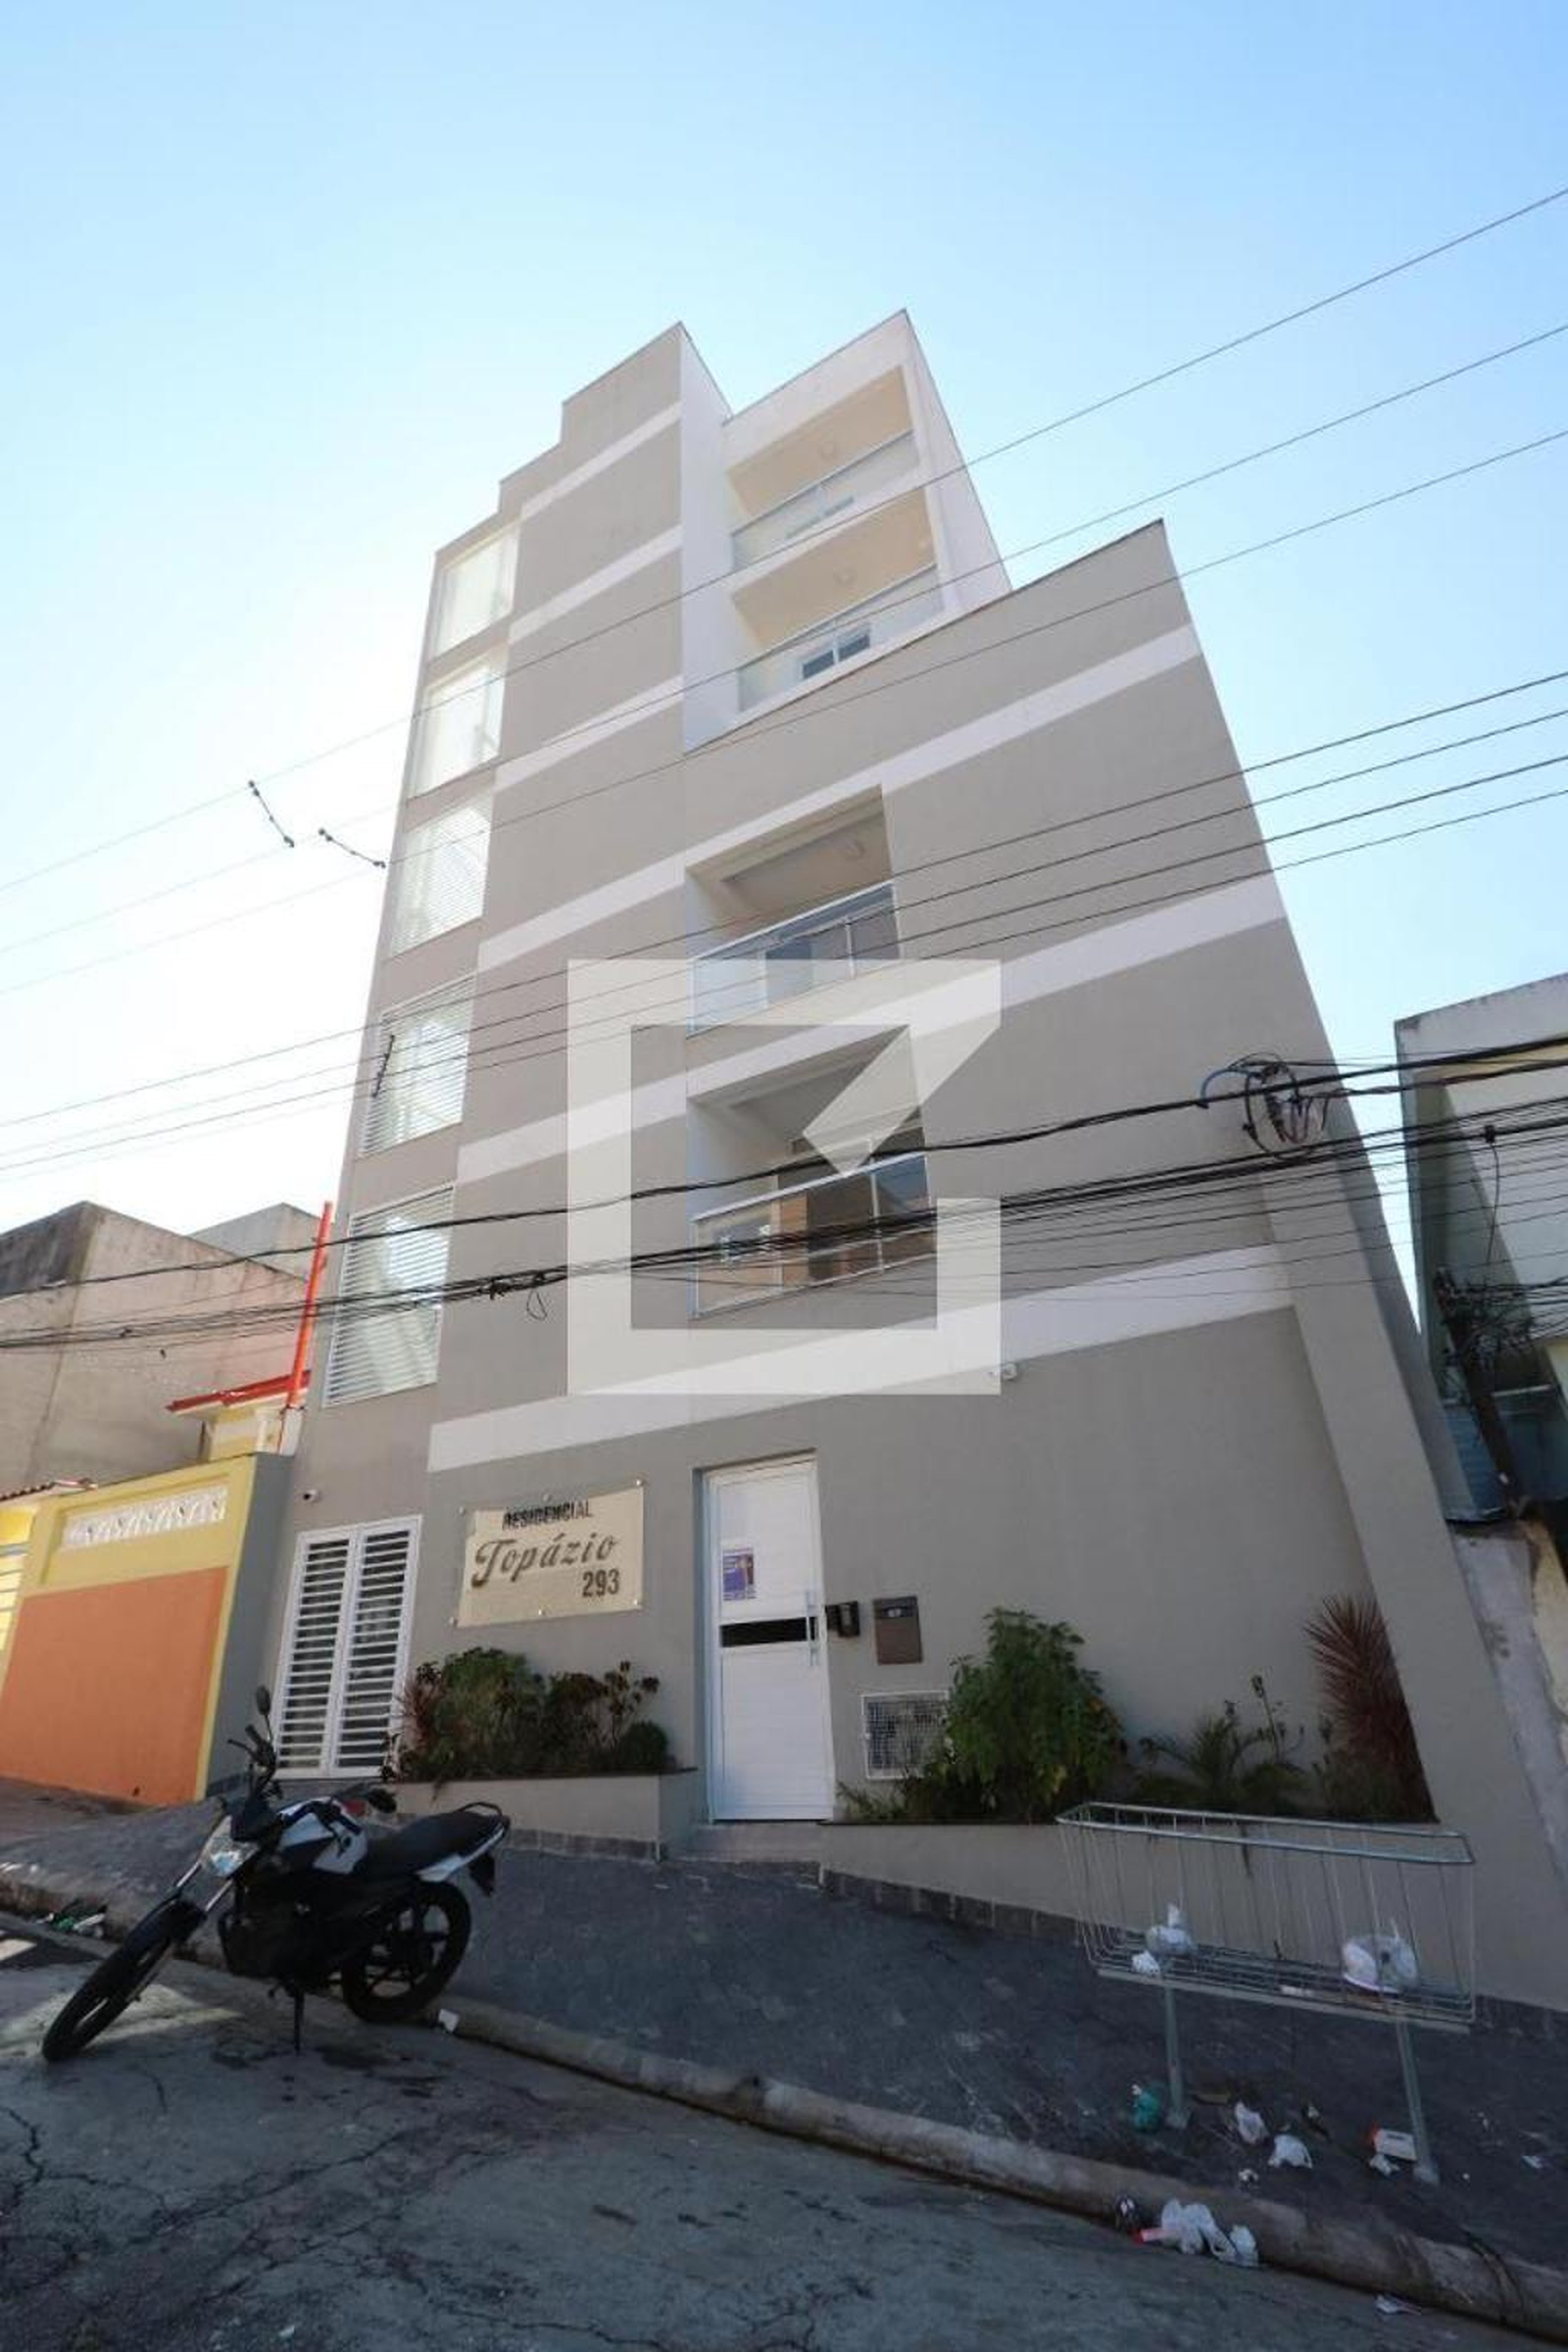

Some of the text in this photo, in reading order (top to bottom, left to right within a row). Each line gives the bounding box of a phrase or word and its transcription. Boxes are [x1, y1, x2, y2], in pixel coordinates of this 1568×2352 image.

[503, 1501, 593, 1530] RESIDENCIAL
[471, 1532, 617, 1588] Topázio
[582, 1568, 619, 1597] 293
